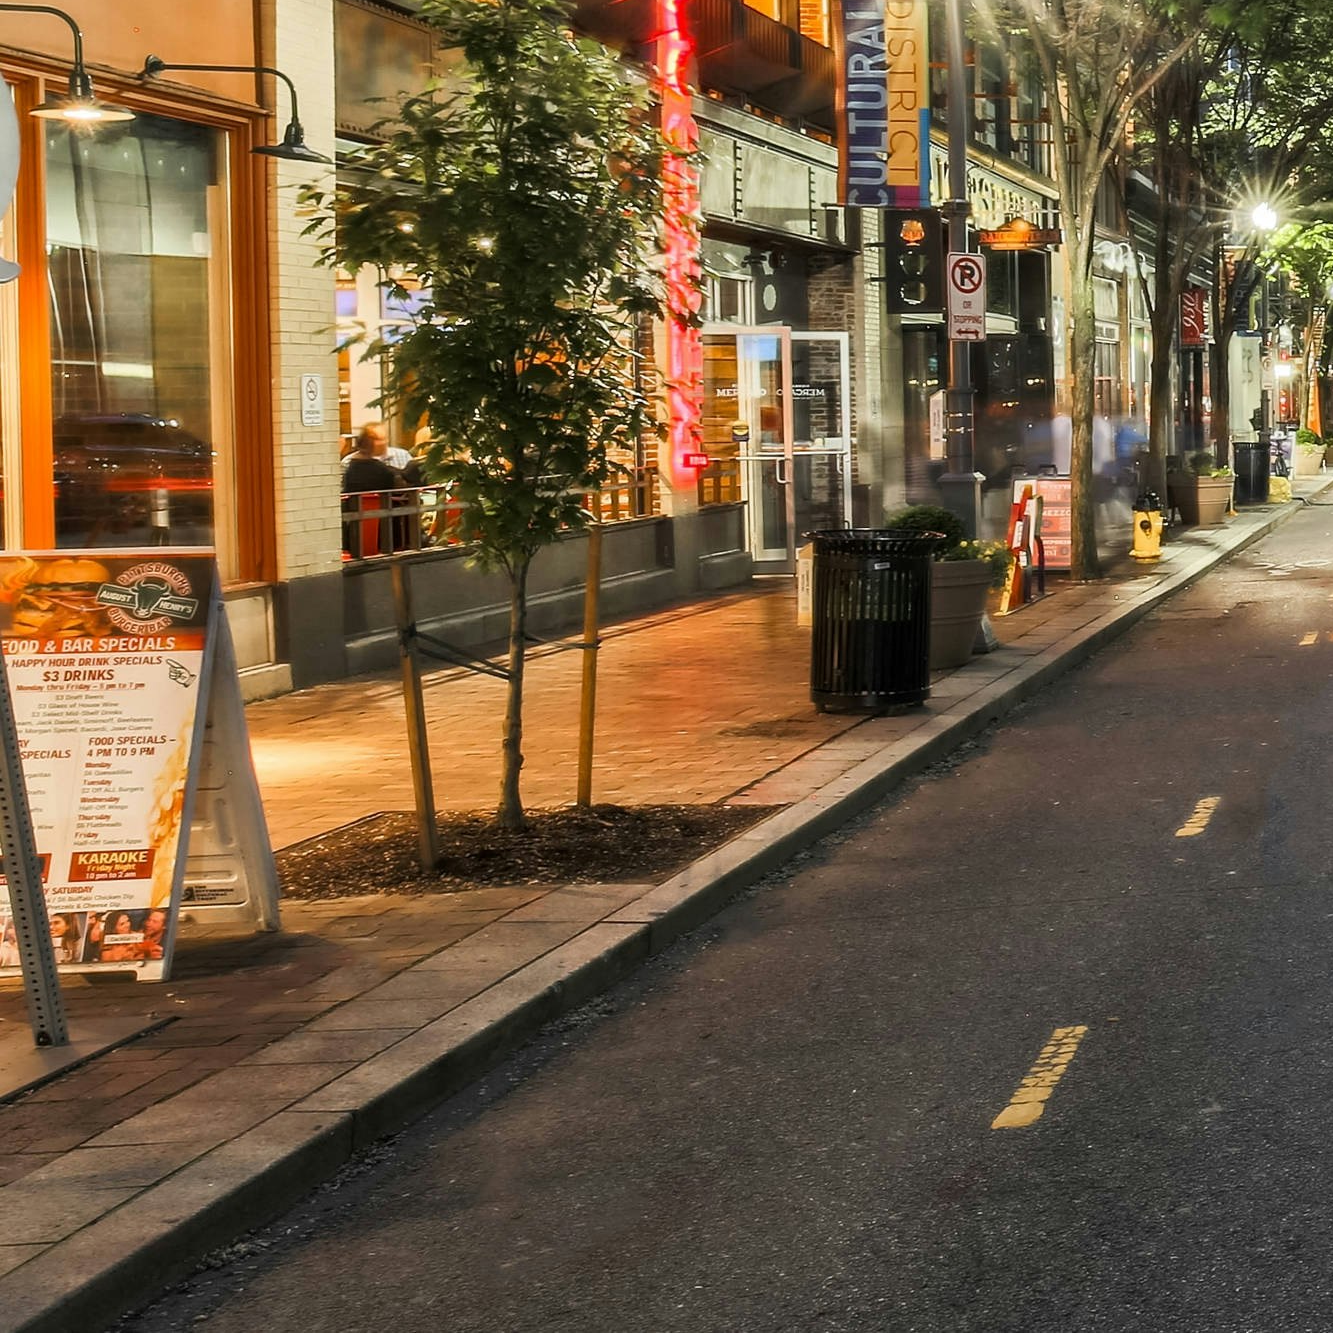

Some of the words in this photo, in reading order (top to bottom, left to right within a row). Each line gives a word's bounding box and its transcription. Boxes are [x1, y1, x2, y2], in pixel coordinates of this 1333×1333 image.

[100, 590, 132, 602] AUGUST
[159, 600, 193, 614] HENRY'S
[108, 608, 145, 635] BURGER
[147, 616, 173, 634] BAR
[2, 640, 39, 654] FOOD
[44, 640, 56, 653] &
[62, 639, 92, 652] BAR
[99, 637, 175, 651] SPECIALS
[12, 659, 46, 668] HAPPY
[50, 658, 75, 666] HOUR
[78, 657, 110, 666] DRINK
[113, 656, 162, 665] SPECIALS
[64, 669, 115, 681] DRINKS
[66, 683, 90, 691] Friday
[89, 737, 113, 746] FOOD
[117, 735, 166, 744] SPECIALS
[20, 750, 71, 759] SPECIALS
[87, 749, 93, 757] 4
[115, 748, 127, 756] TO
[130, 748, 137, 756] 9
[139, 747, 155, 755] PM
[80, 796, 120, 804] Wednesday
[78, 814, 111, 822] Thursday
[77, 851, 148, 865] KARAOKE
[95, 872, 107, 880] pm
[52, 886, 93, 894] SATURDAY
